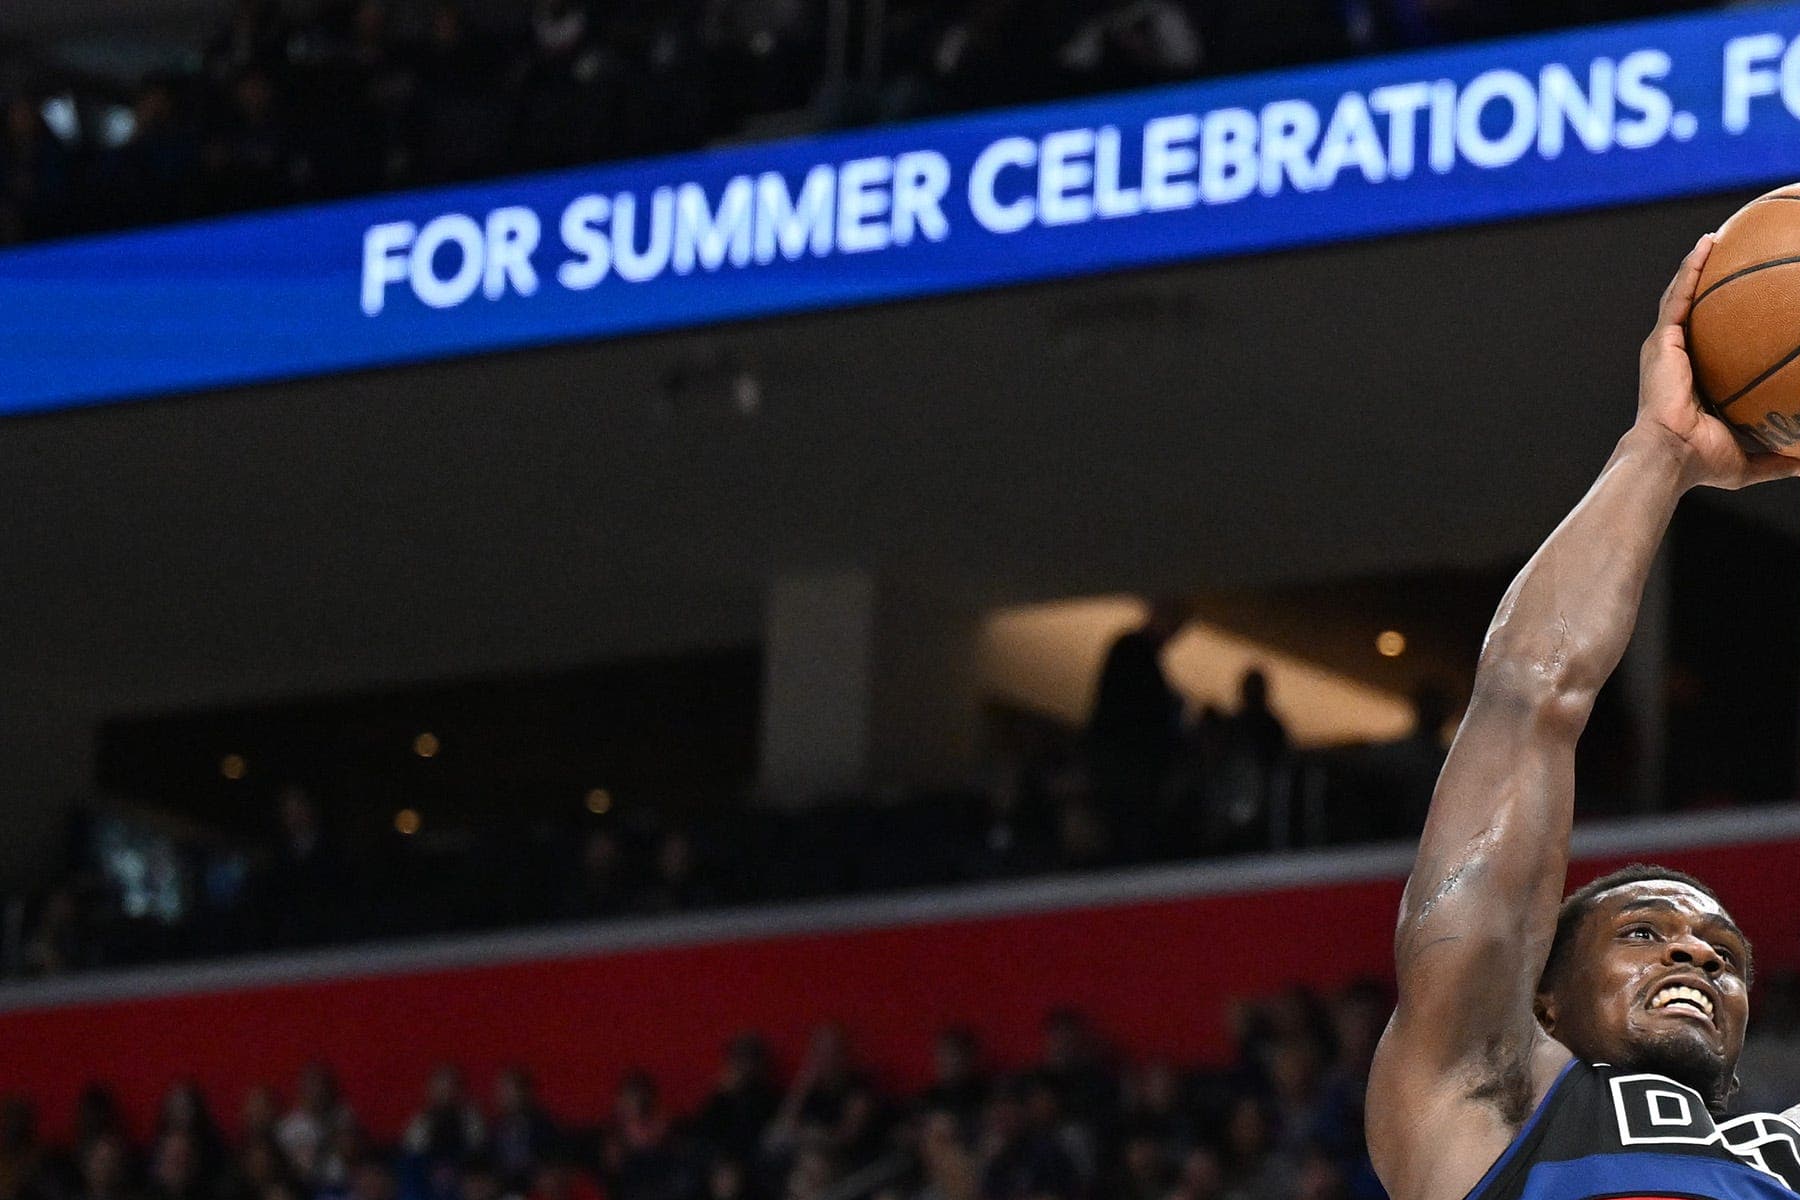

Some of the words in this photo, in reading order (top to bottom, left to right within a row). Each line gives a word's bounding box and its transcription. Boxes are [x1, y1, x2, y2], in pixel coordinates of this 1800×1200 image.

[361, 207, 539, 315] FOR
[558, 151, 949, 290] SUMMER
[967, 49, 1699, 235] CELEBRATIONS.
